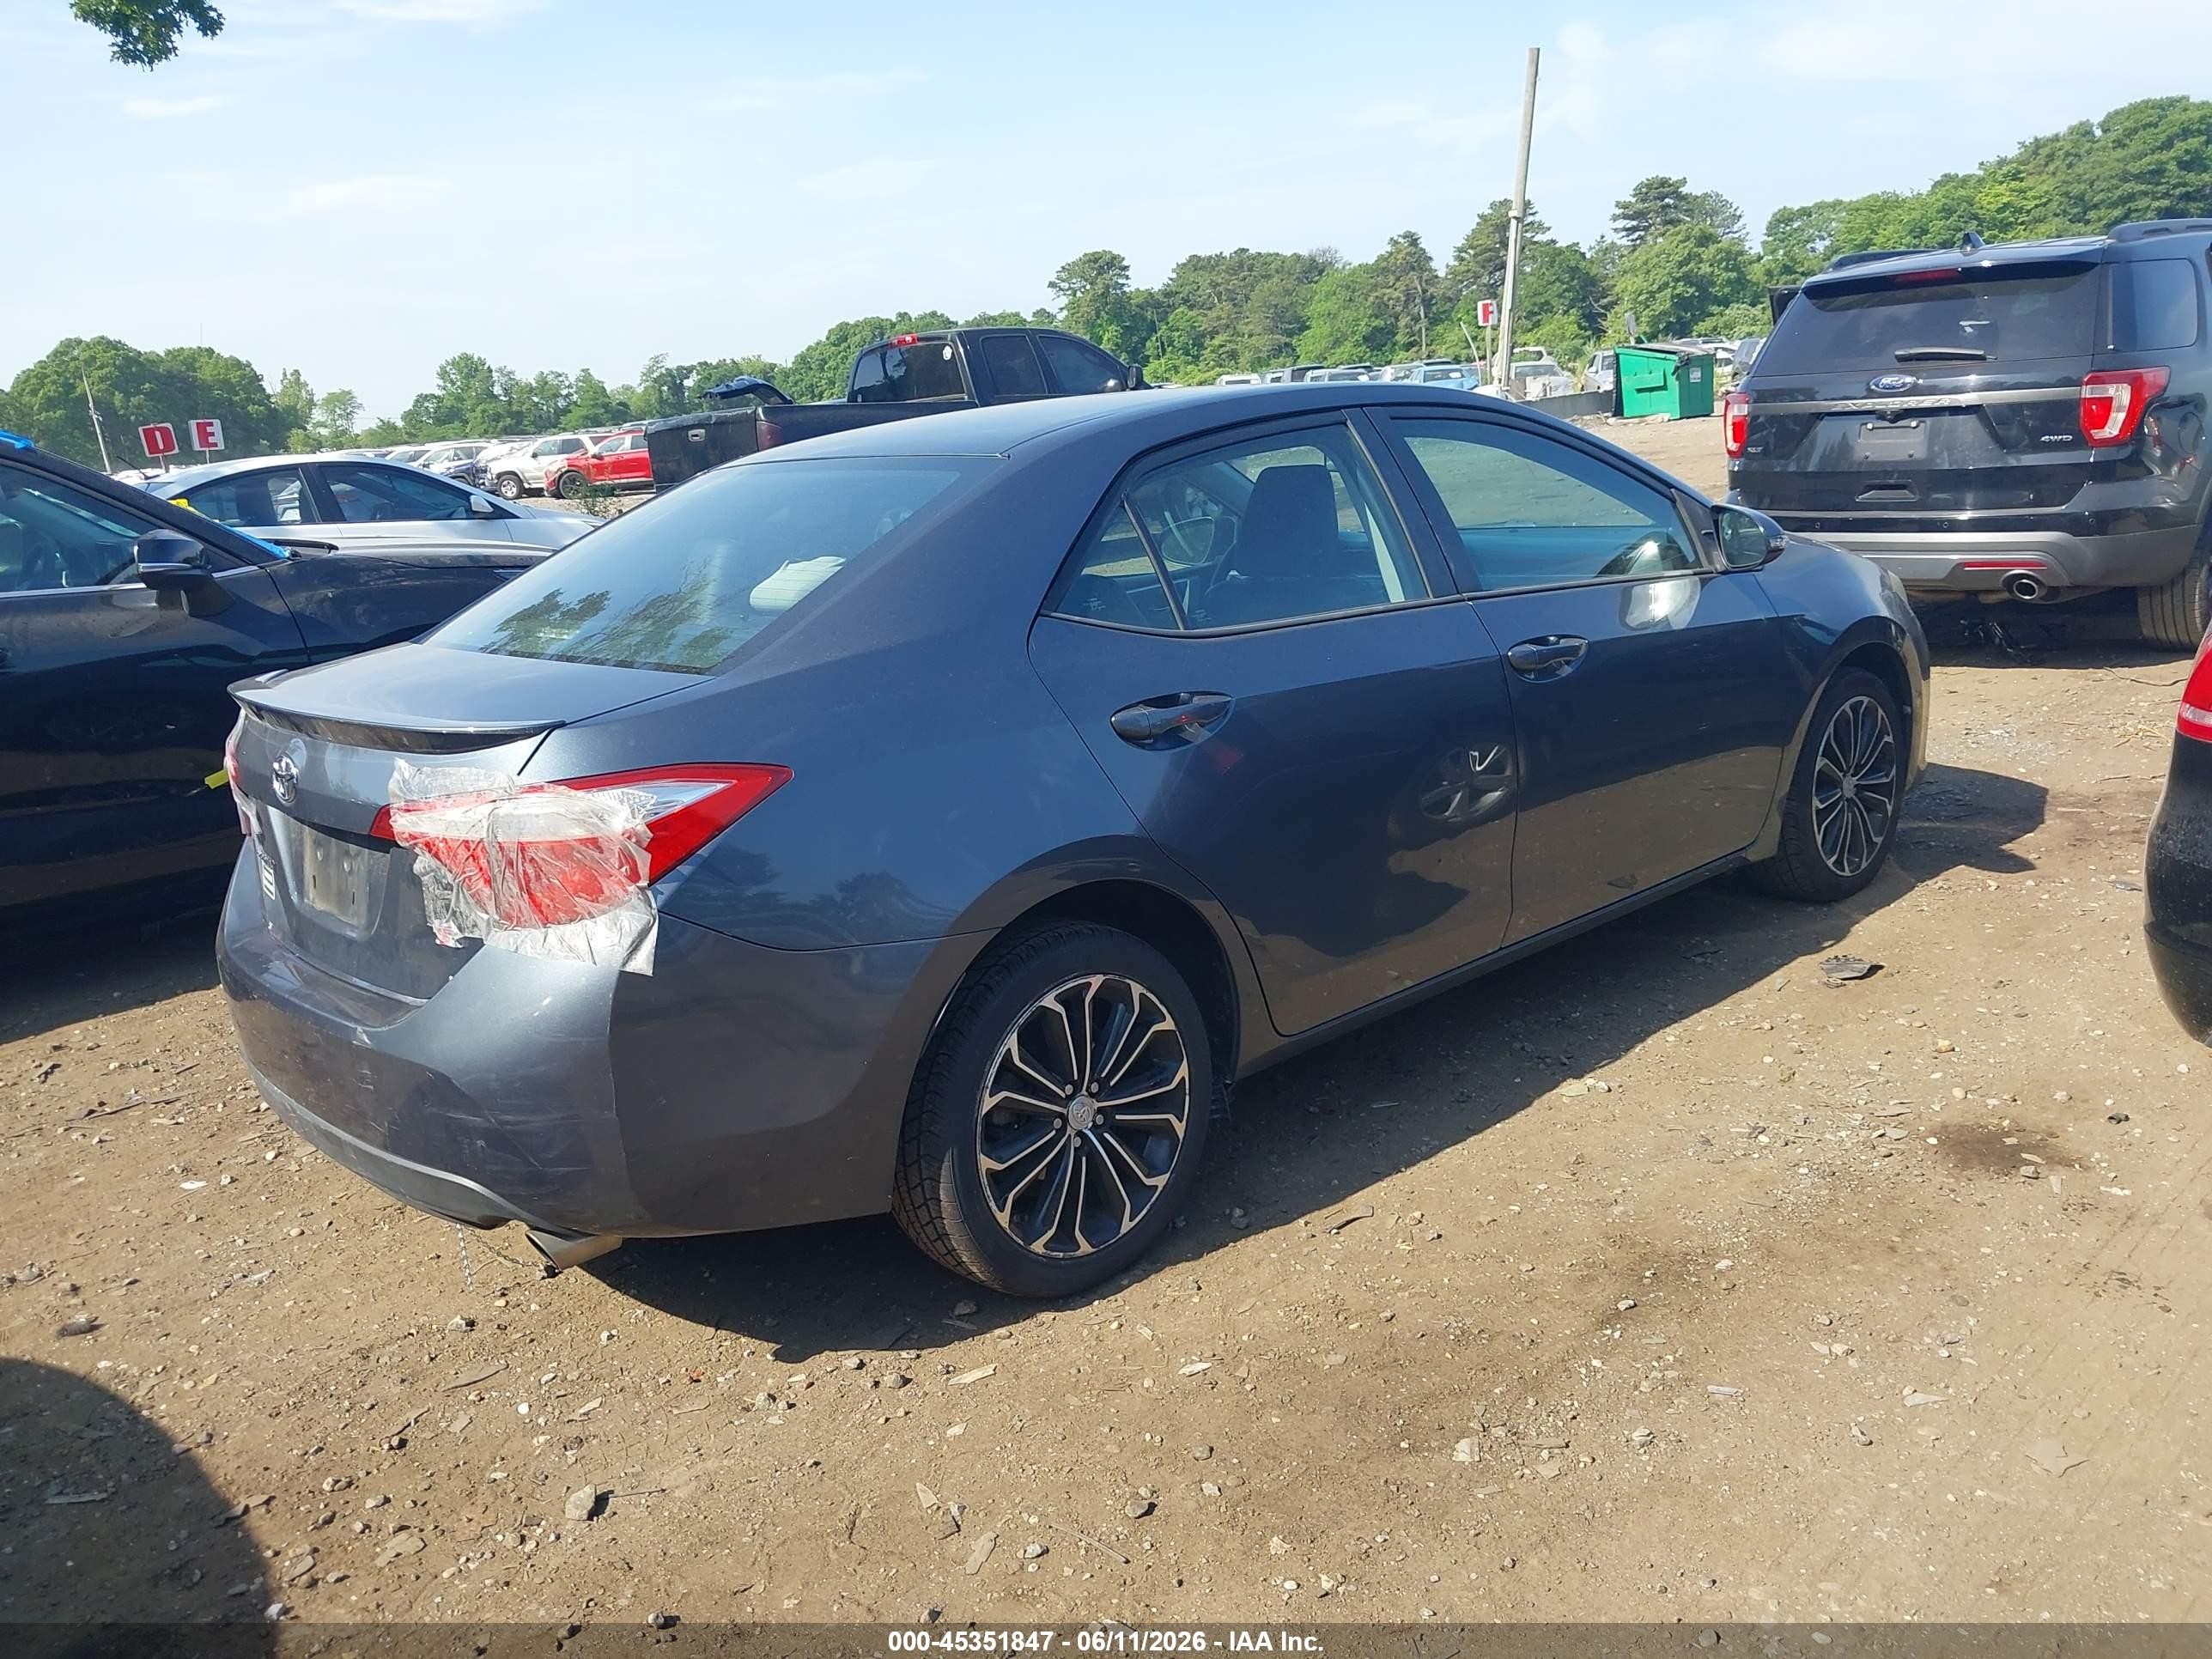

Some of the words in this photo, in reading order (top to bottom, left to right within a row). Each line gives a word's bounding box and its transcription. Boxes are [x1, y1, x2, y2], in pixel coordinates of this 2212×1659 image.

[1482, 302, 1494, 324] F
[1832, 398, 1952, 411] EXPLORER
[142, 426, 176, 455] D
[196, 422, 219, 448] E
